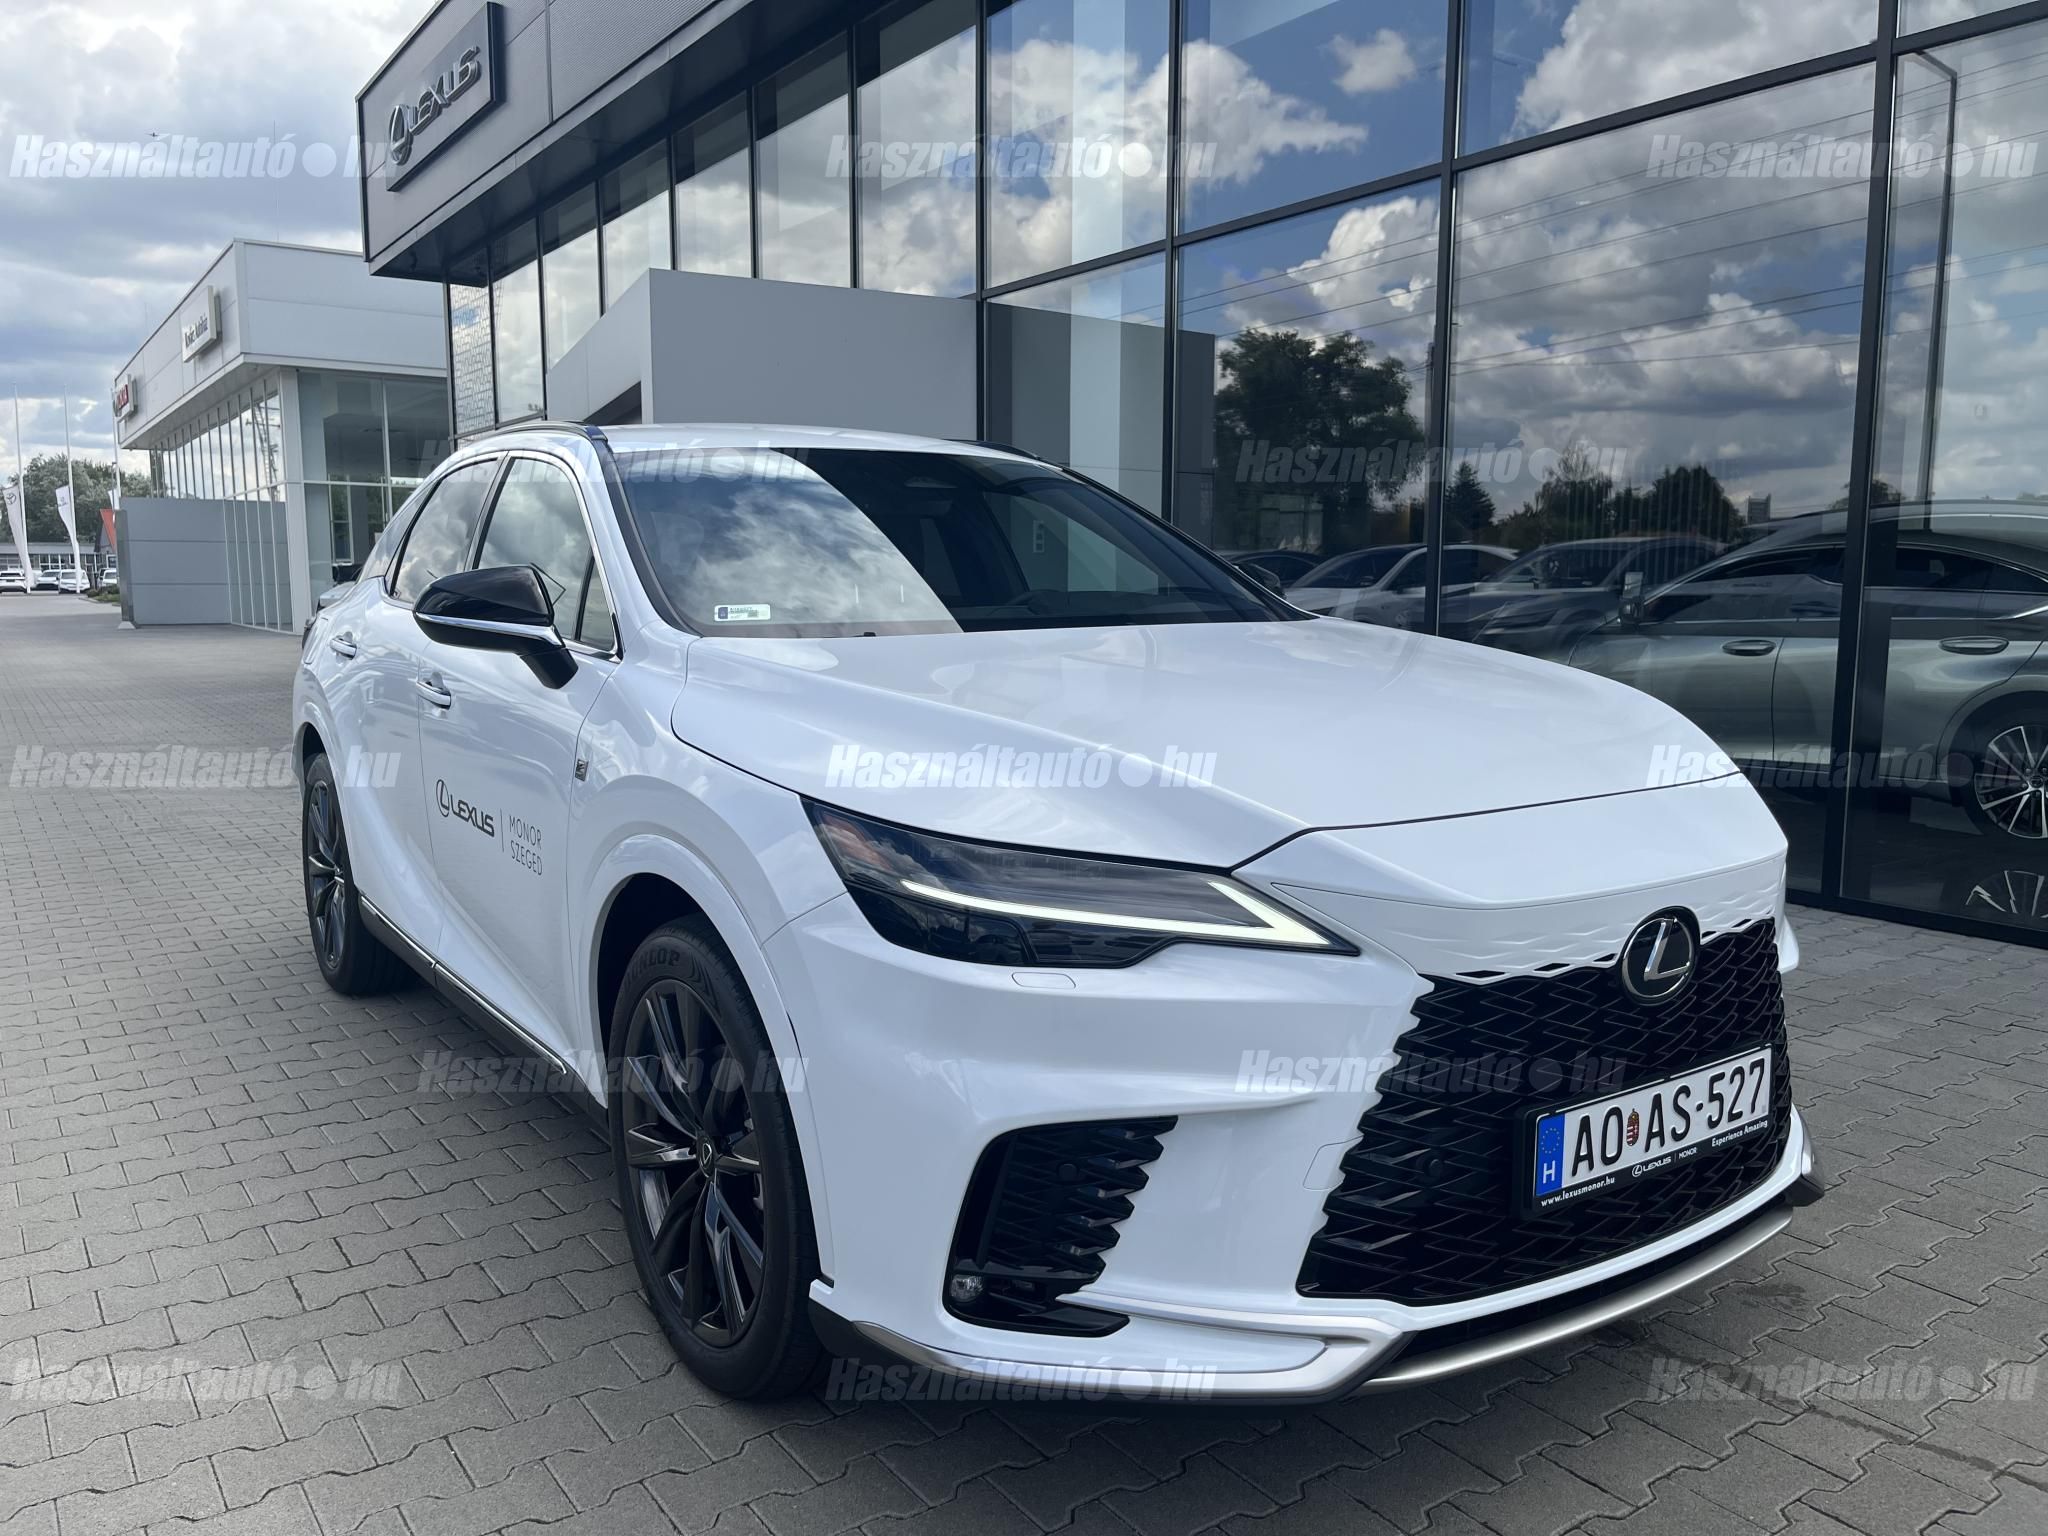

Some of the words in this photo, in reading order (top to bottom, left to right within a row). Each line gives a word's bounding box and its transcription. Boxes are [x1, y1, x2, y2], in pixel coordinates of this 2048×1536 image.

[408, 46, 481, 136] LEXUS
[449, 794, 494, 837] LEXUS
[509, 814, 542, 850] MONOR
[511, 840, 543, 875] SZEGED
[1571, 1105, 1624, 1178] AO
[1644, 1057, 1765, 1153] AS-527
[1711, 1129, 1743, 1147] Experience
[1743, 1118, 1768, 1134] Amazing
[1542, 1159, 1556, 1185] H
[1642, 1156, 1672, 1172] LEXUS
[1678, 1147, 1698, 1160] MONOR
[1540, 1175, 1616, 1207] www.lexusmonor.hu
